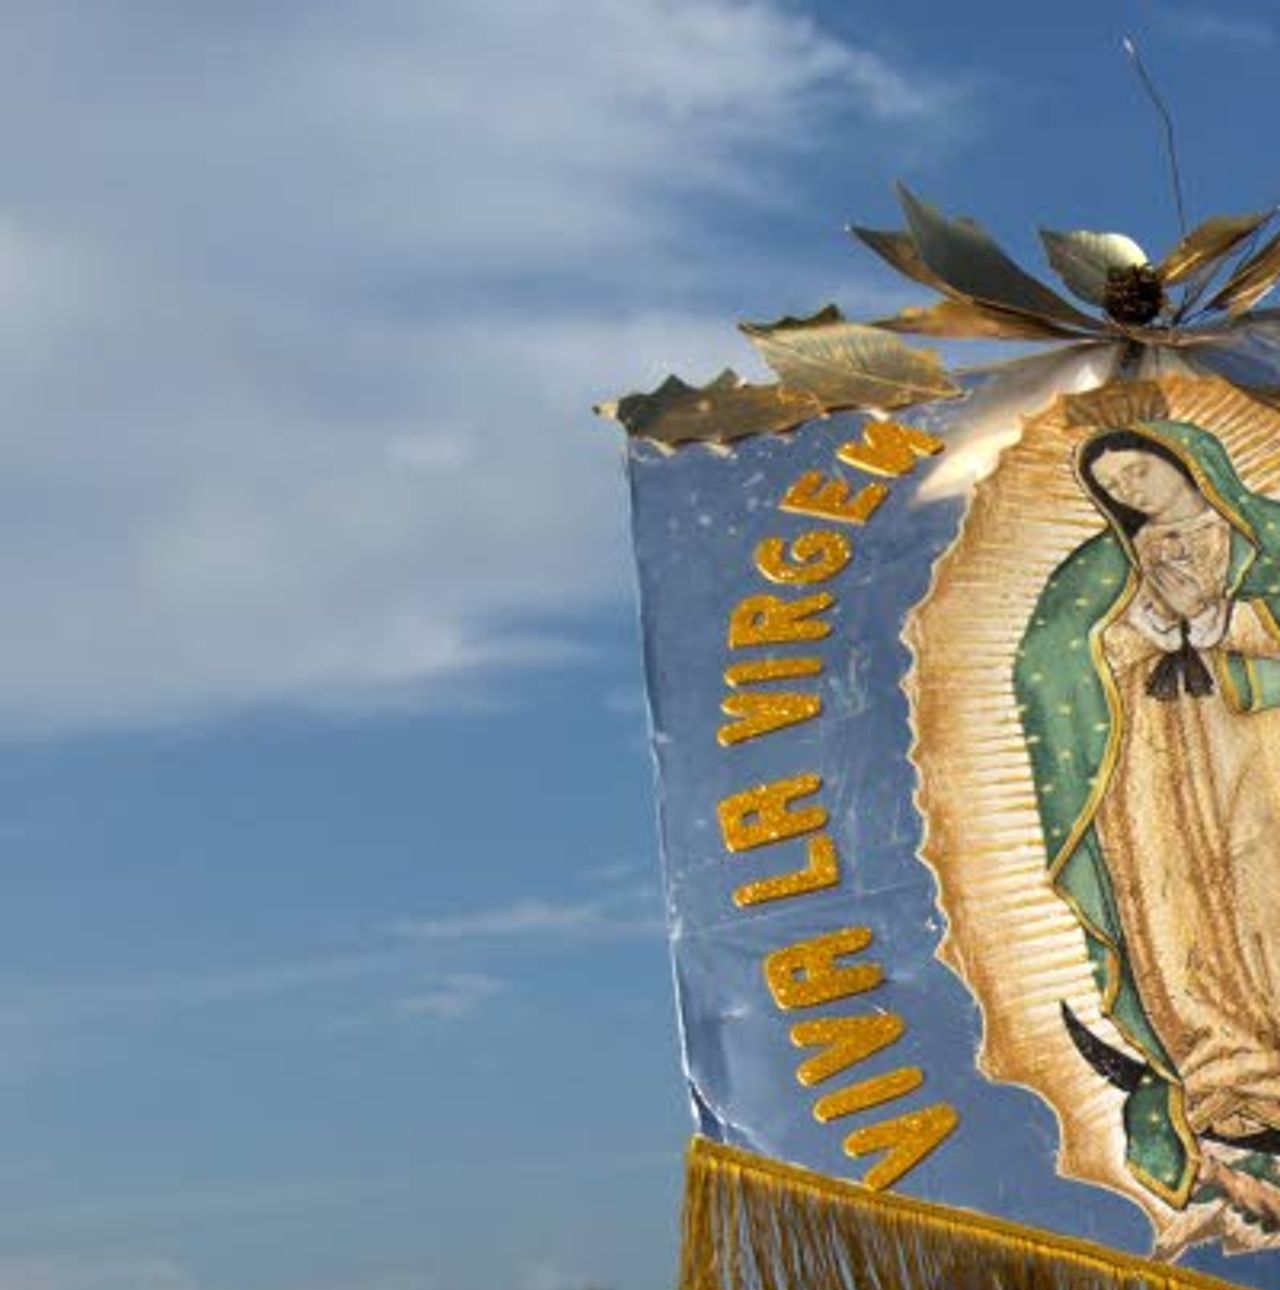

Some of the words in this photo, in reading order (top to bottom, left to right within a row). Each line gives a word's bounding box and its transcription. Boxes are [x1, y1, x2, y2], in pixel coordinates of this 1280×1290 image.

[717, 419, 945, 748] VIRGEN
[717, 773, 840, 906] LA
[763, 926, 959, 1191] VIVA
